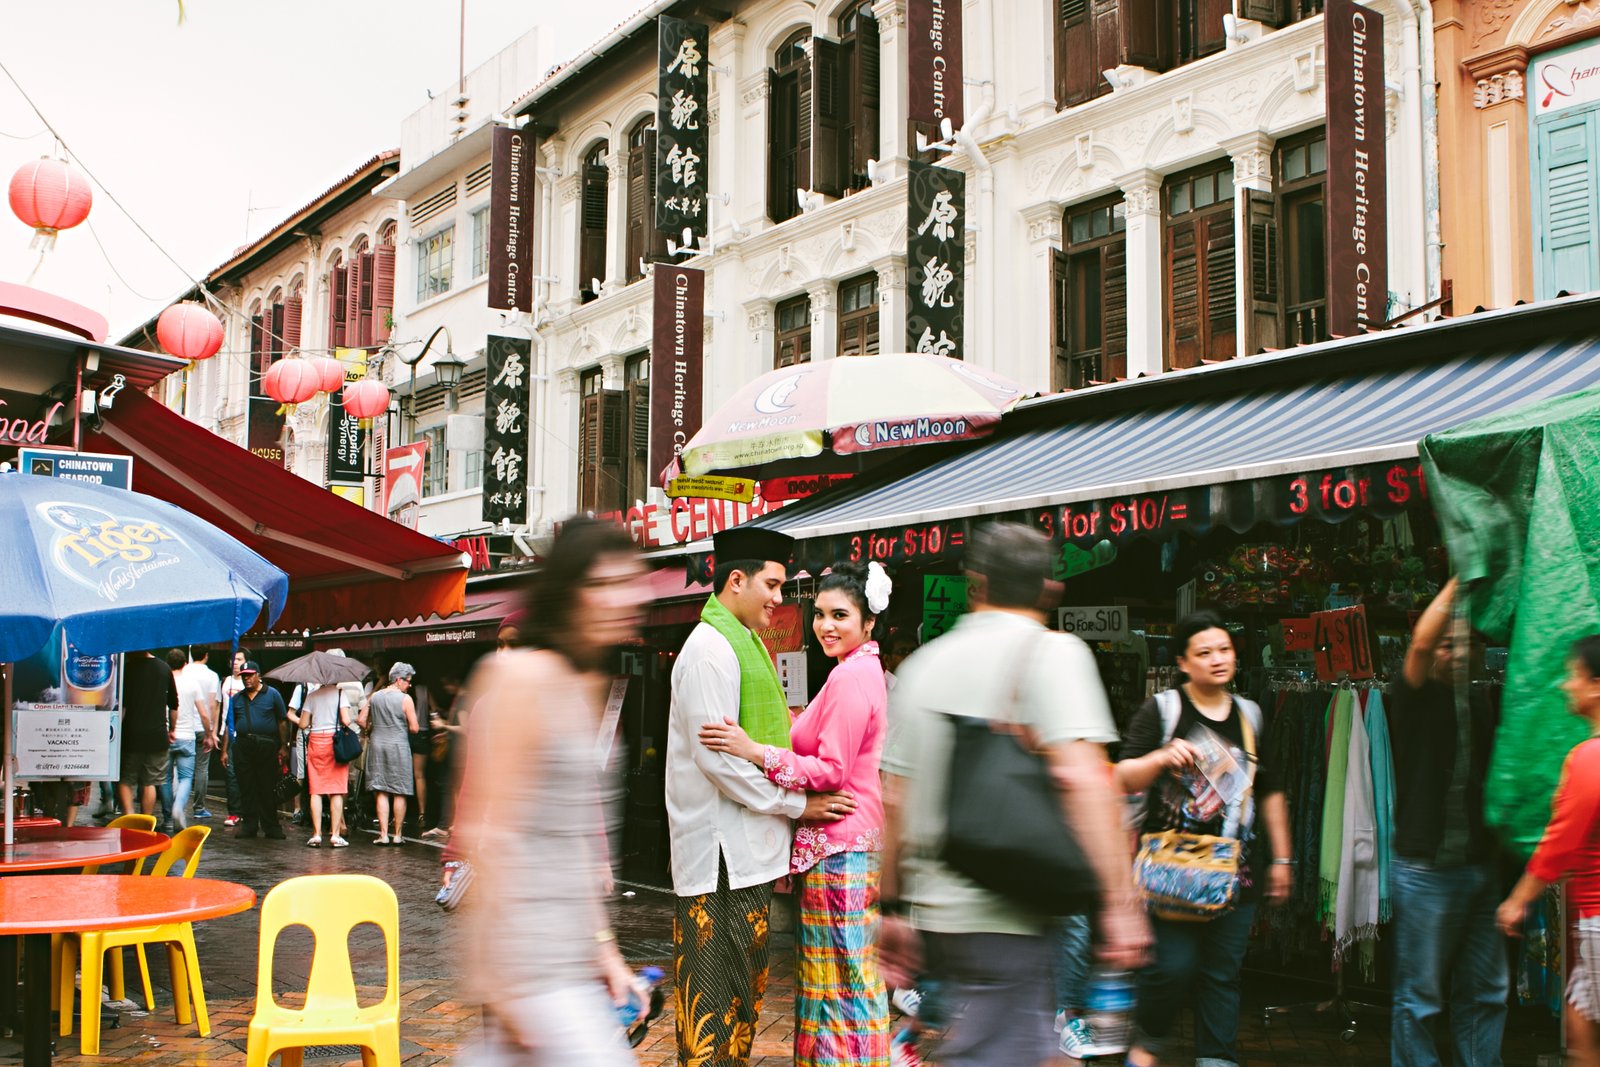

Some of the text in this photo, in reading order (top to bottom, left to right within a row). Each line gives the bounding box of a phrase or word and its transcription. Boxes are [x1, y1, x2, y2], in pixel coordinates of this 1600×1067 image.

[933, 56, 947, 118] Centre
[1352, 11, 1367, 141] Chinatown
[505, 134, 522, 306] Chinatown Heritage Centre
[1352, 149, 1369, 255] Heritage
[671, 273, 688, 455] Chinatown Heritage Ce
[337, 419, 349, 462] Synergy
[59, 459, 113, 473] CHINATOWN
[1289, 464, 1427, 514] 3 for $1
[59, 519, 173, 568] Tiger
[1039, 511, 1055, 541] 3
[1062, 506, 1100, 539] for
[850, 536, 861, 562] 3
[868, 533, 898, 559] for
[925, 577, 952, 611] 4
[446, 631, 462, 642] Heritage
[462, 630, 476, 640] Centre
[1063, 611, 1075, 632] 6
[1077, 619, 1094, 632] FOR
